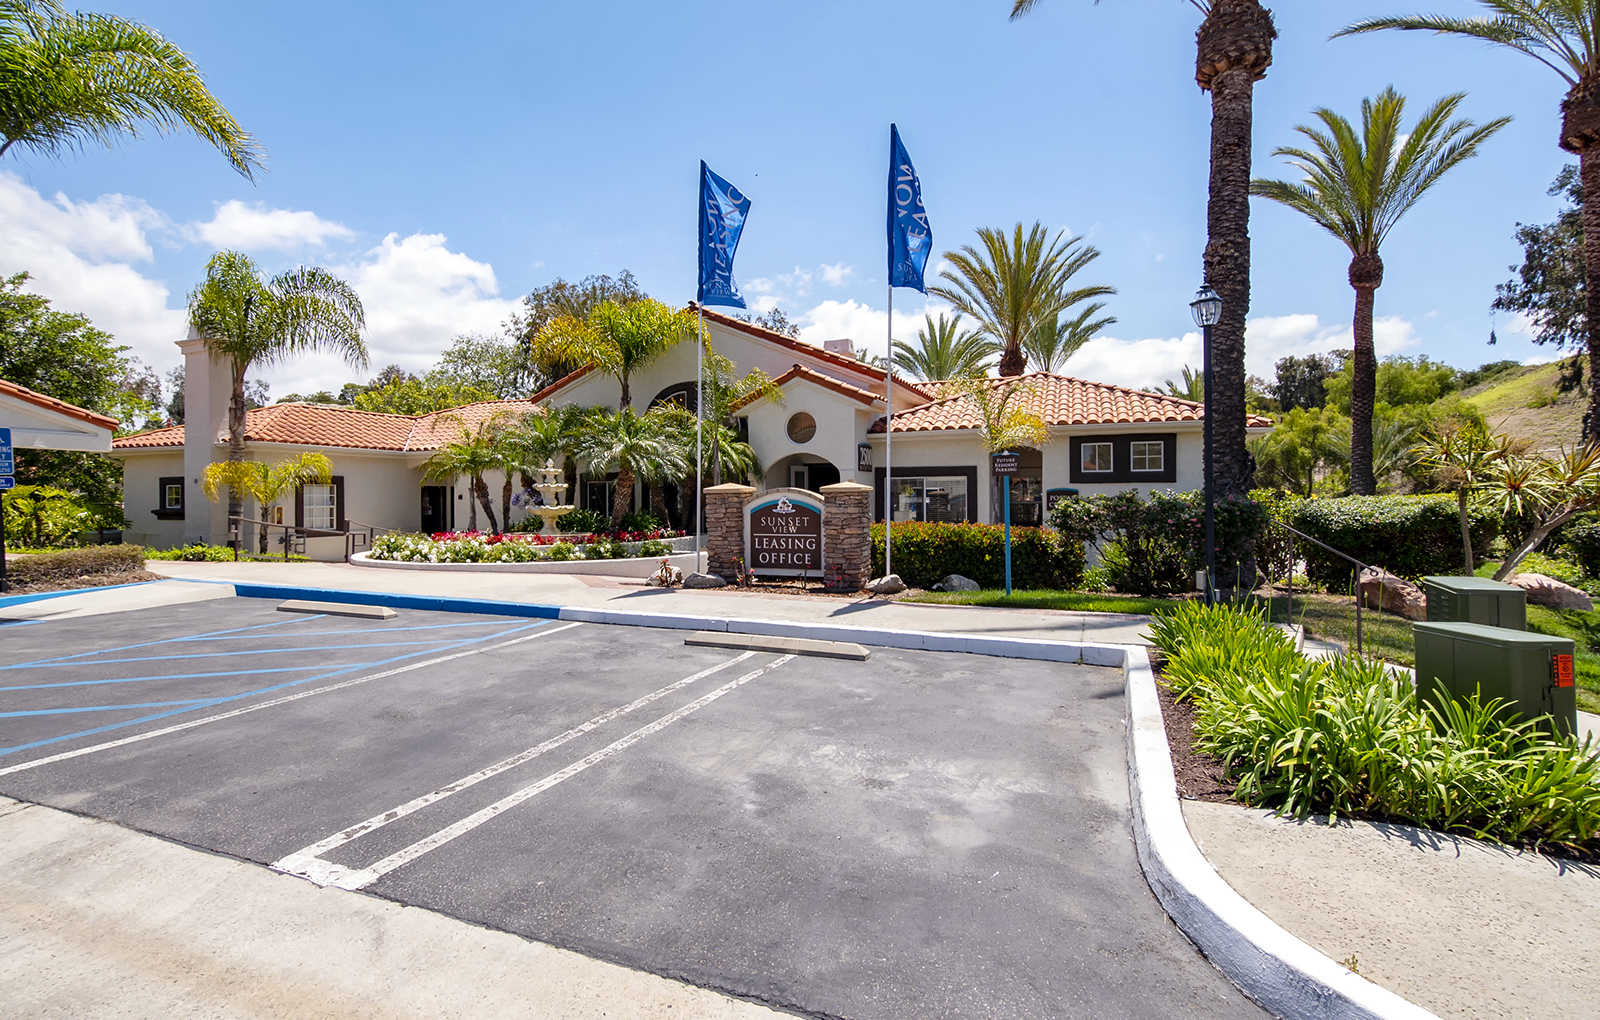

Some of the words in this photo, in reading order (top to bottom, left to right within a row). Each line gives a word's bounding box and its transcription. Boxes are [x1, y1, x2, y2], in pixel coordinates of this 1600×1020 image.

[760, 516, 809, 527] SUNSET
[754, 537, 816, 550] LEASING
[759, 552, 811, 565] OFFICE
